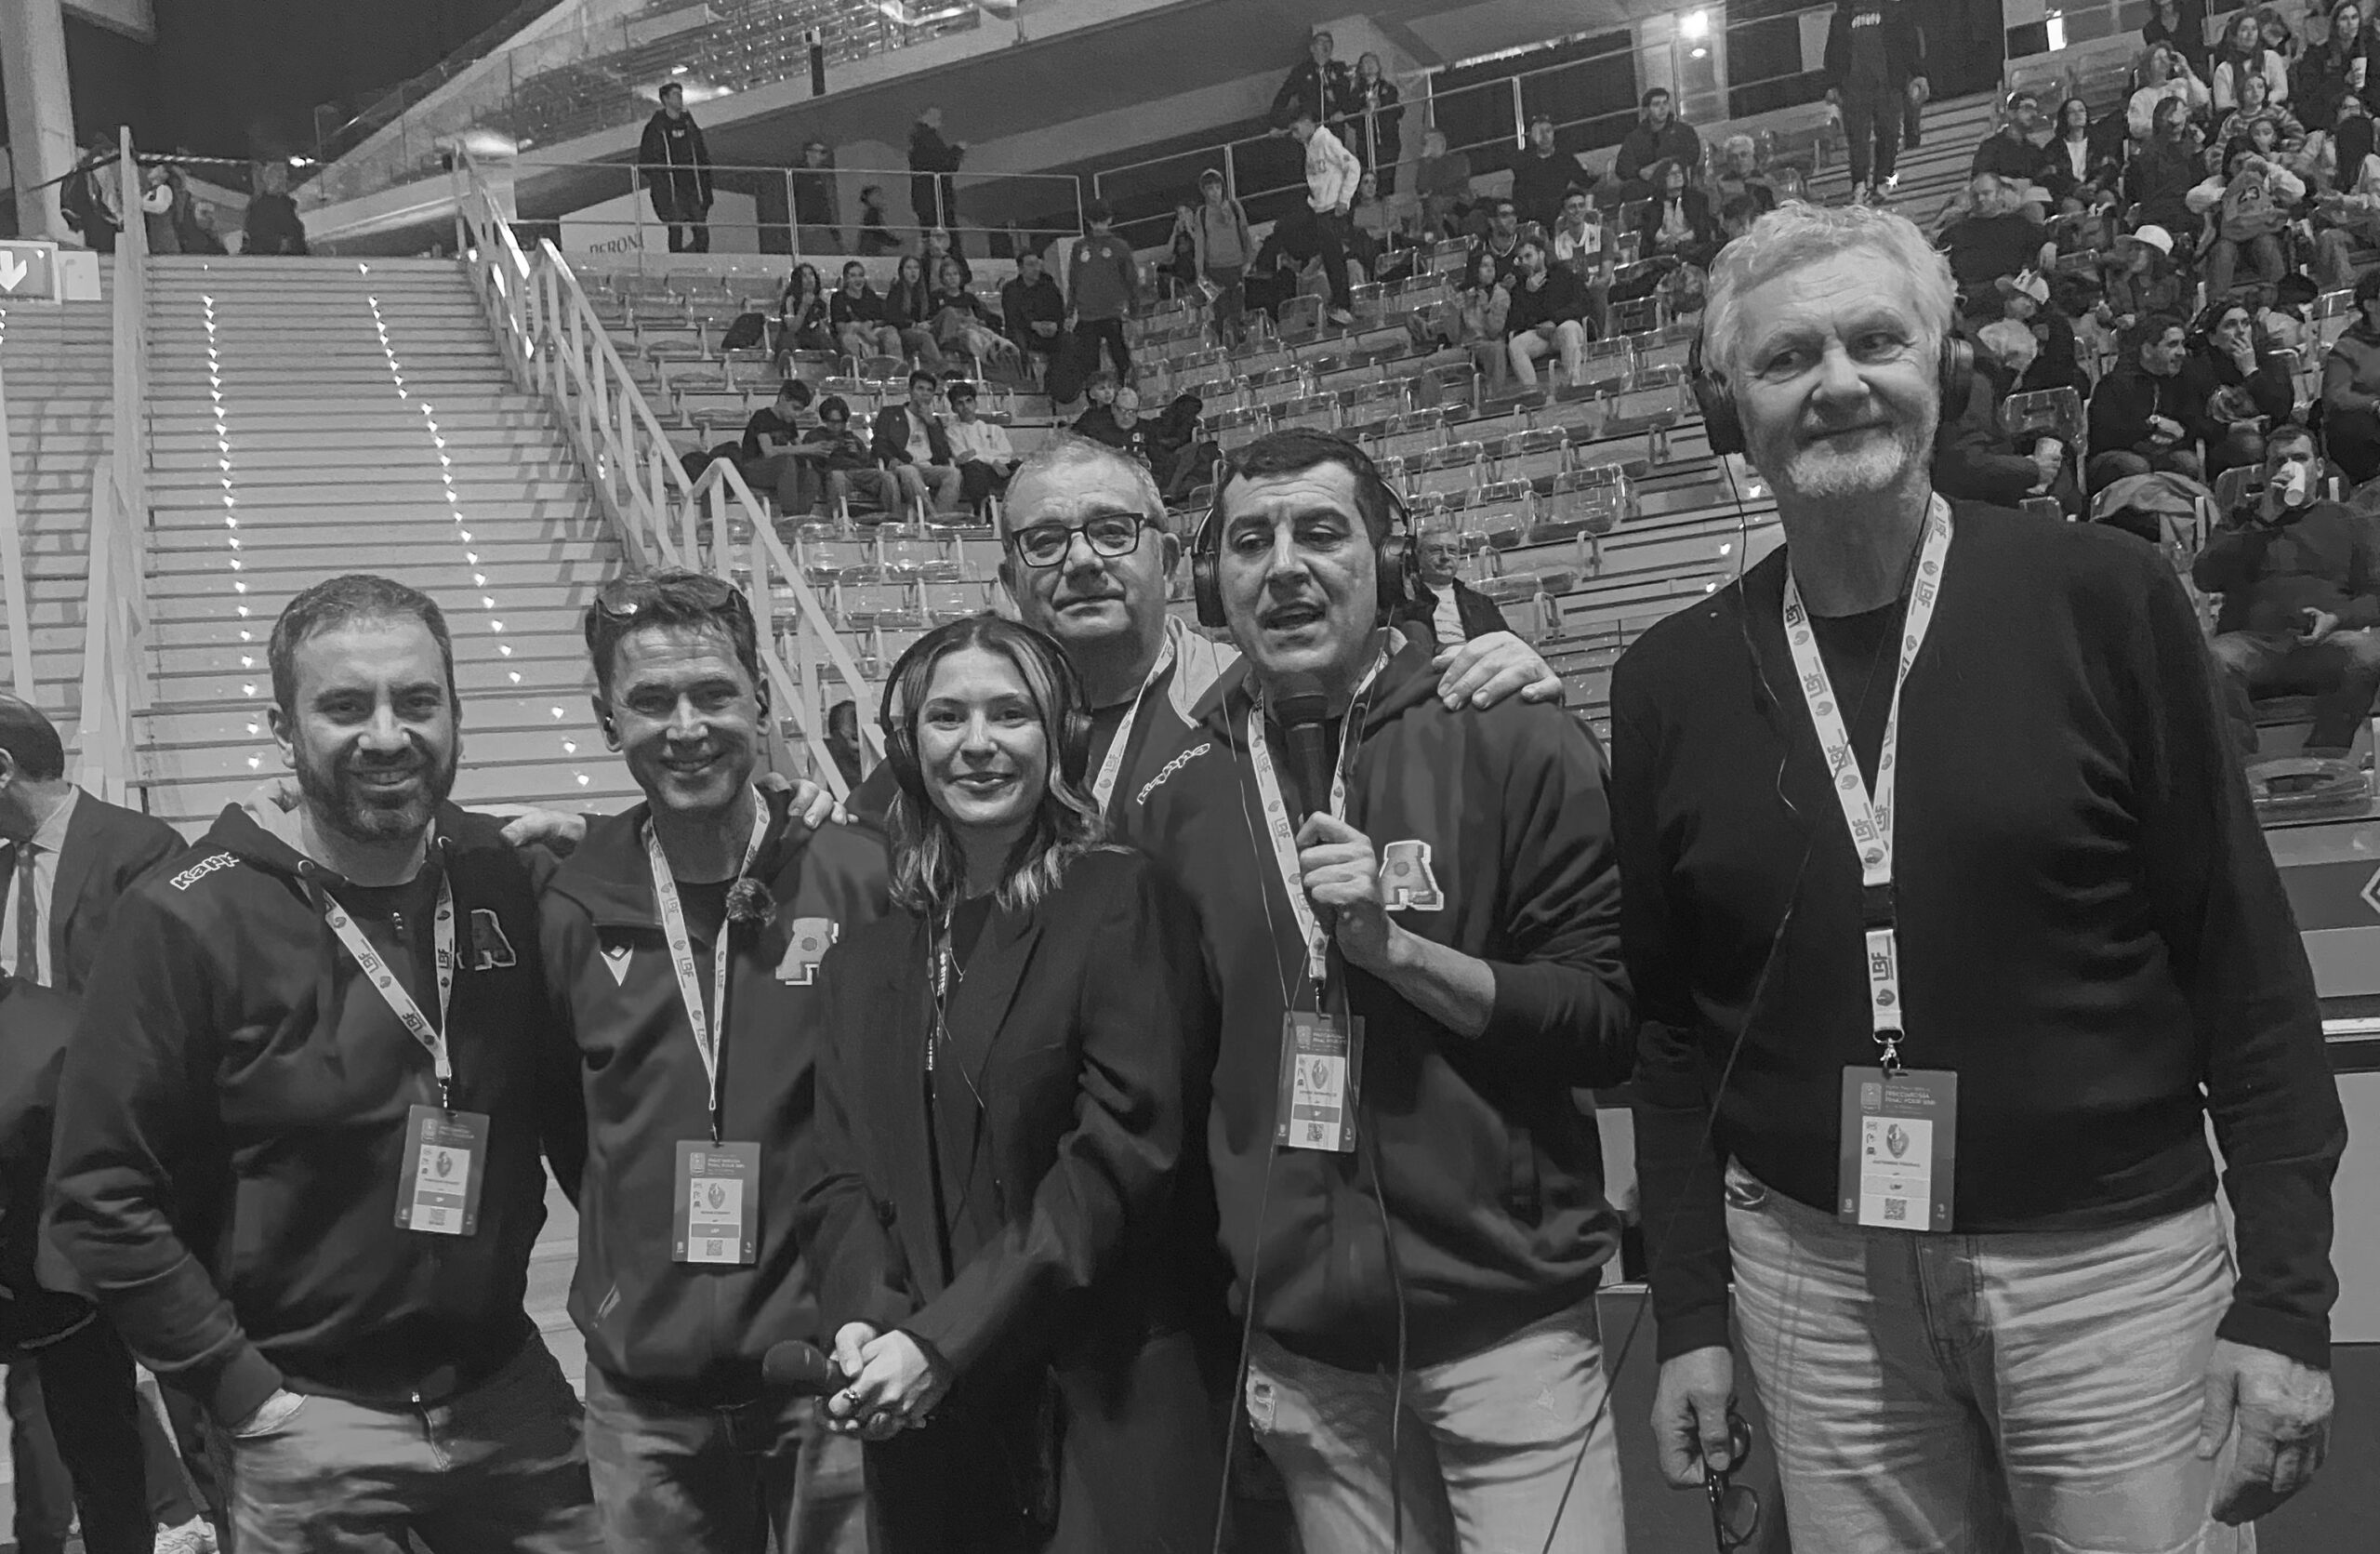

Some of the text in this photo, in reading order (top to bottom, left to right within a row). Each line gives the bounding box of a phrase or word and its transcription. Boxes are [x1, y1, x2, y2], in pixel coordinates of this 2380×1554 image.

[2238, 186, 2260, 206] 23
[1918, 580, 1936, 609] LBF
[1785, 603, 1802, 629] LBF
[1804, 672, 1825, 699] LBF
[1104, 753, 1117, 773] LBF
[1258, 751, 1272, 774] LBF
[1827, 745, 1848, 771] LBF
[1137, 743, 1210, 806] Kappa
[1275, 817, 1291, 839] LBF
[1852, 819, 1875, 843] LBF
[668, 897, 681, 914] LBF
[357, 951, 379, 974] LBF
[438, 948, 451, 969] LBF
[679, 957, 694, 978] LBF
[1871, 951, 1890, 982] LBF
[402, 1012, 423, 1032] LBF
